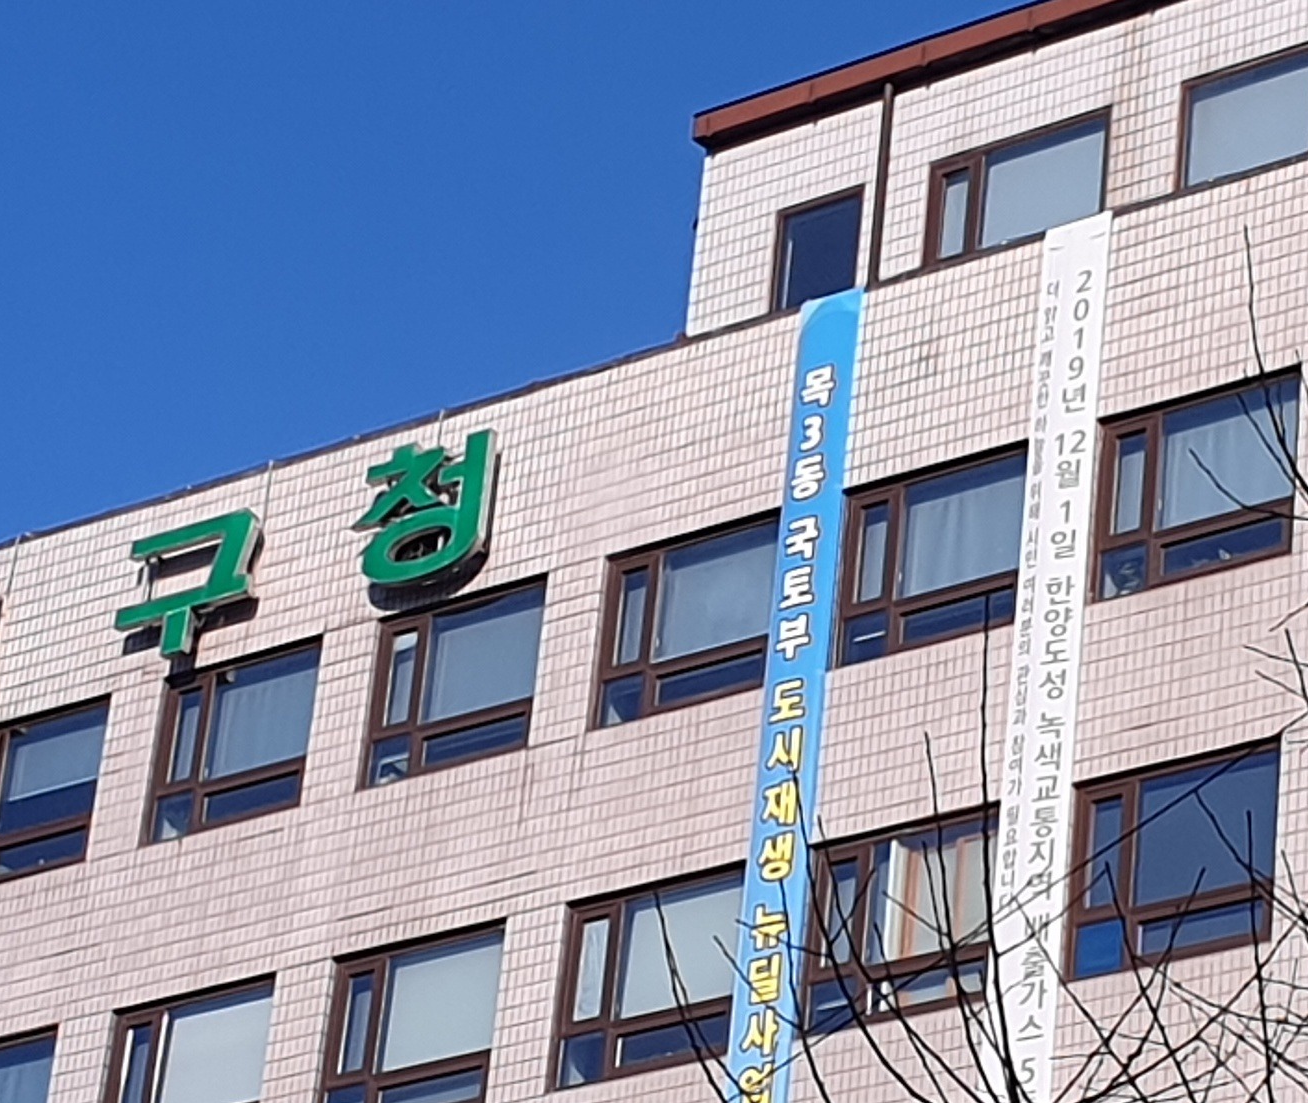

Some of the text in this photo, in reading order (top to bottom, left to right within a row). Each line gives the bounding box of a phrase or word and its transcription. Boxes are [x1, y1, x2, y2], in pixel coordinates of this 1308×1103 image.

[1062, 269, 1093, 414] 2019년
[791, 364, 836, 501] 목3동
[1053, 429, 1087, 490] 12월
[774, 515, 821, 660] 국토부
[1050, 499, 1077, 560] 1일
[1038, 574, 1075, 700] 한양도성
[757, 677, 805, 883] 도시재생
[1027, 711, 1067, 901] 녹색교통지역
